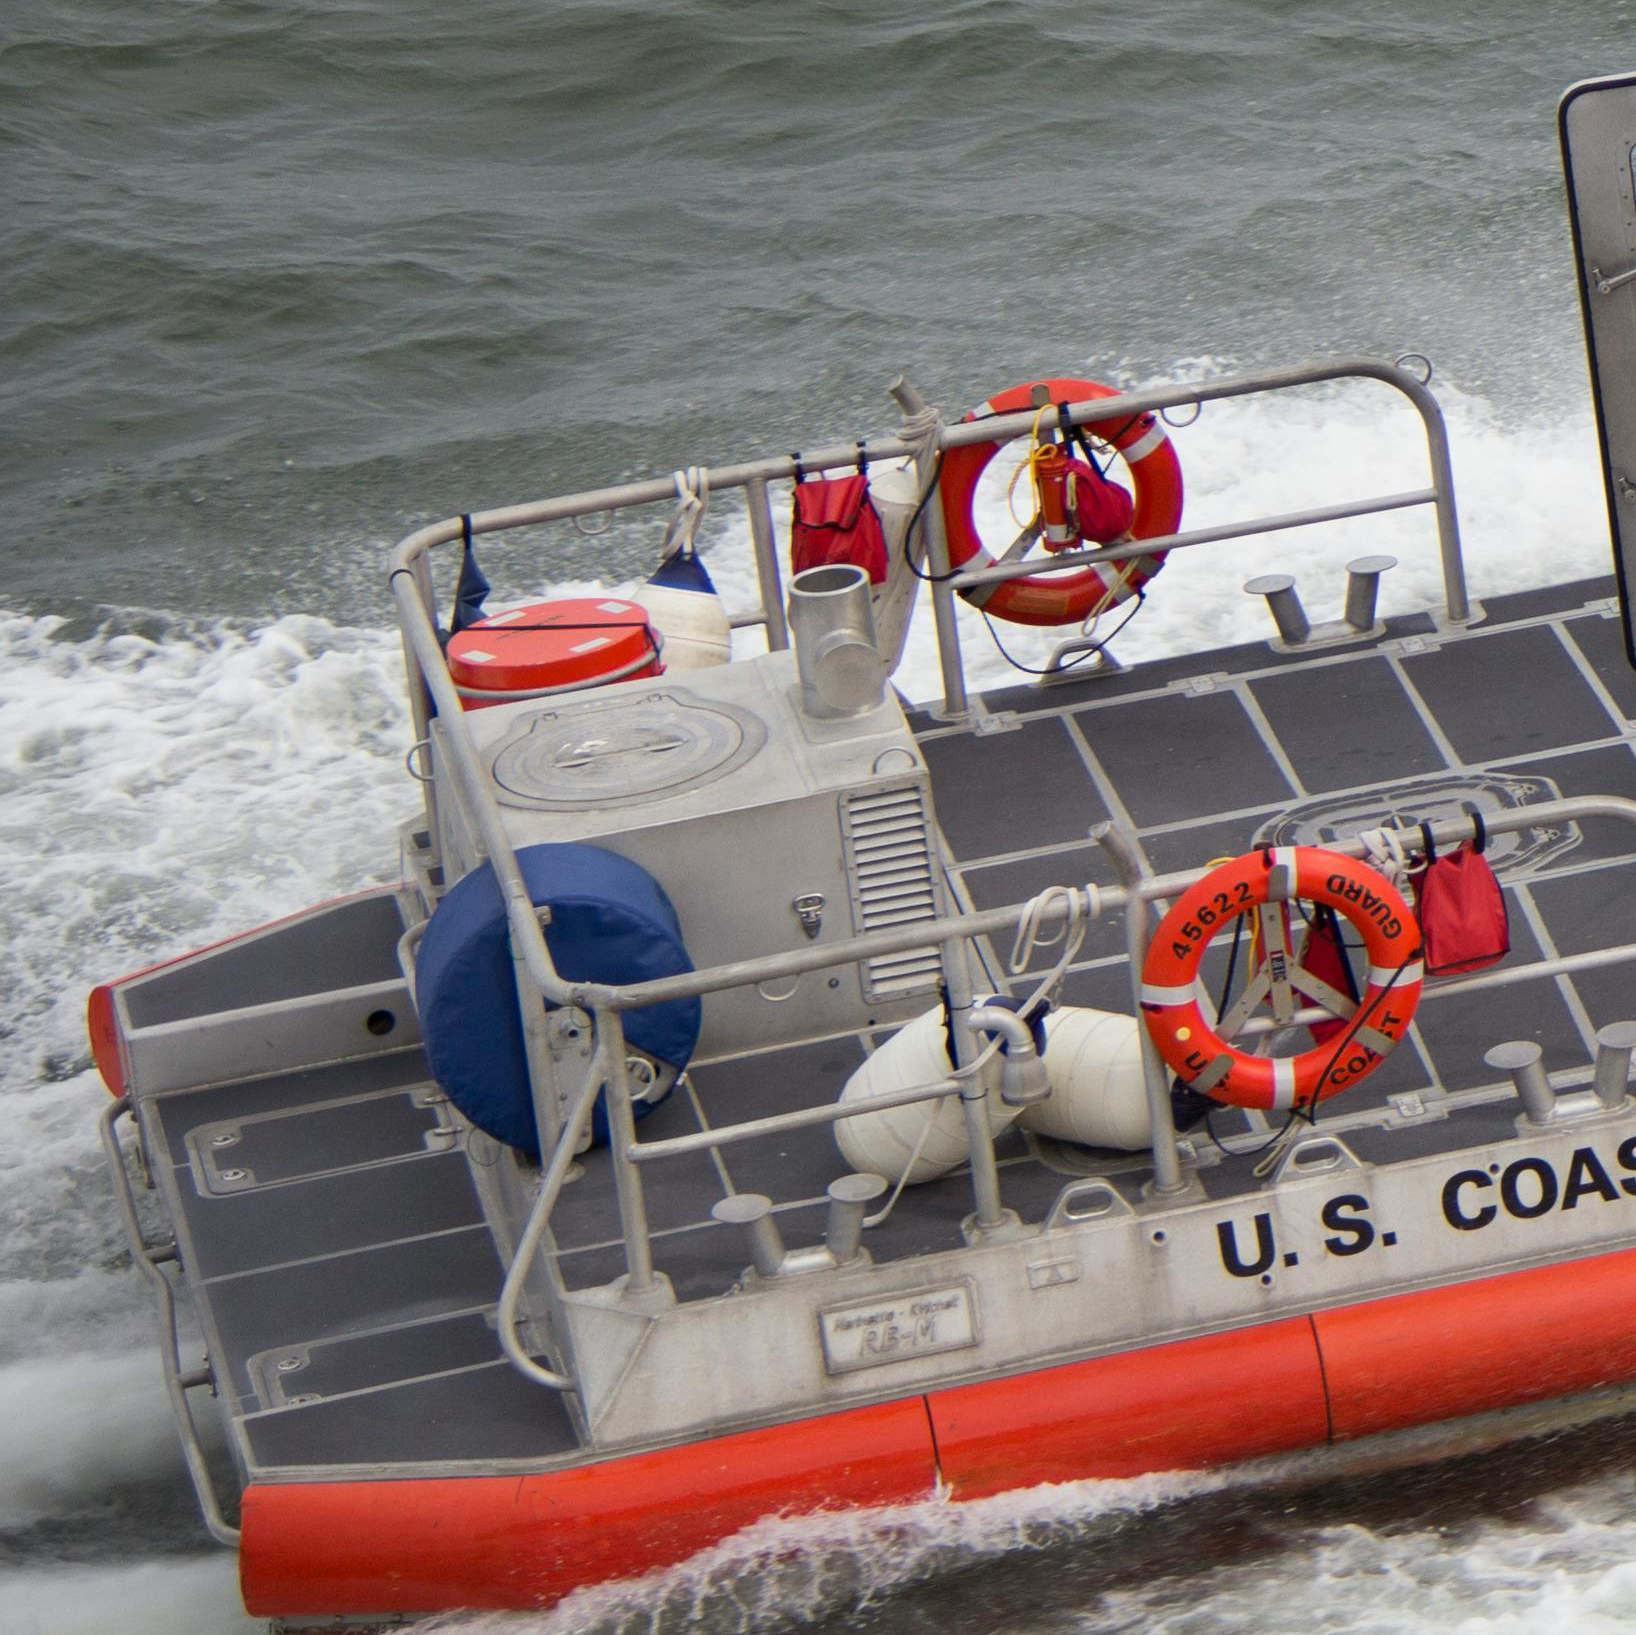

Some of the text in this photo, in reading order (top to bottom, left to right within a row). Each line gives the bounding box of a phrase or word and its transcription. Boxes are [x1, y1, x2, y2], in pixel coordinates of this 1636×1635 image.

[1171, 881, 1256, 961] 45622
[1326, 874, 1403, 940] GUARD
[859, 1316, 937, 1357] RB-M
